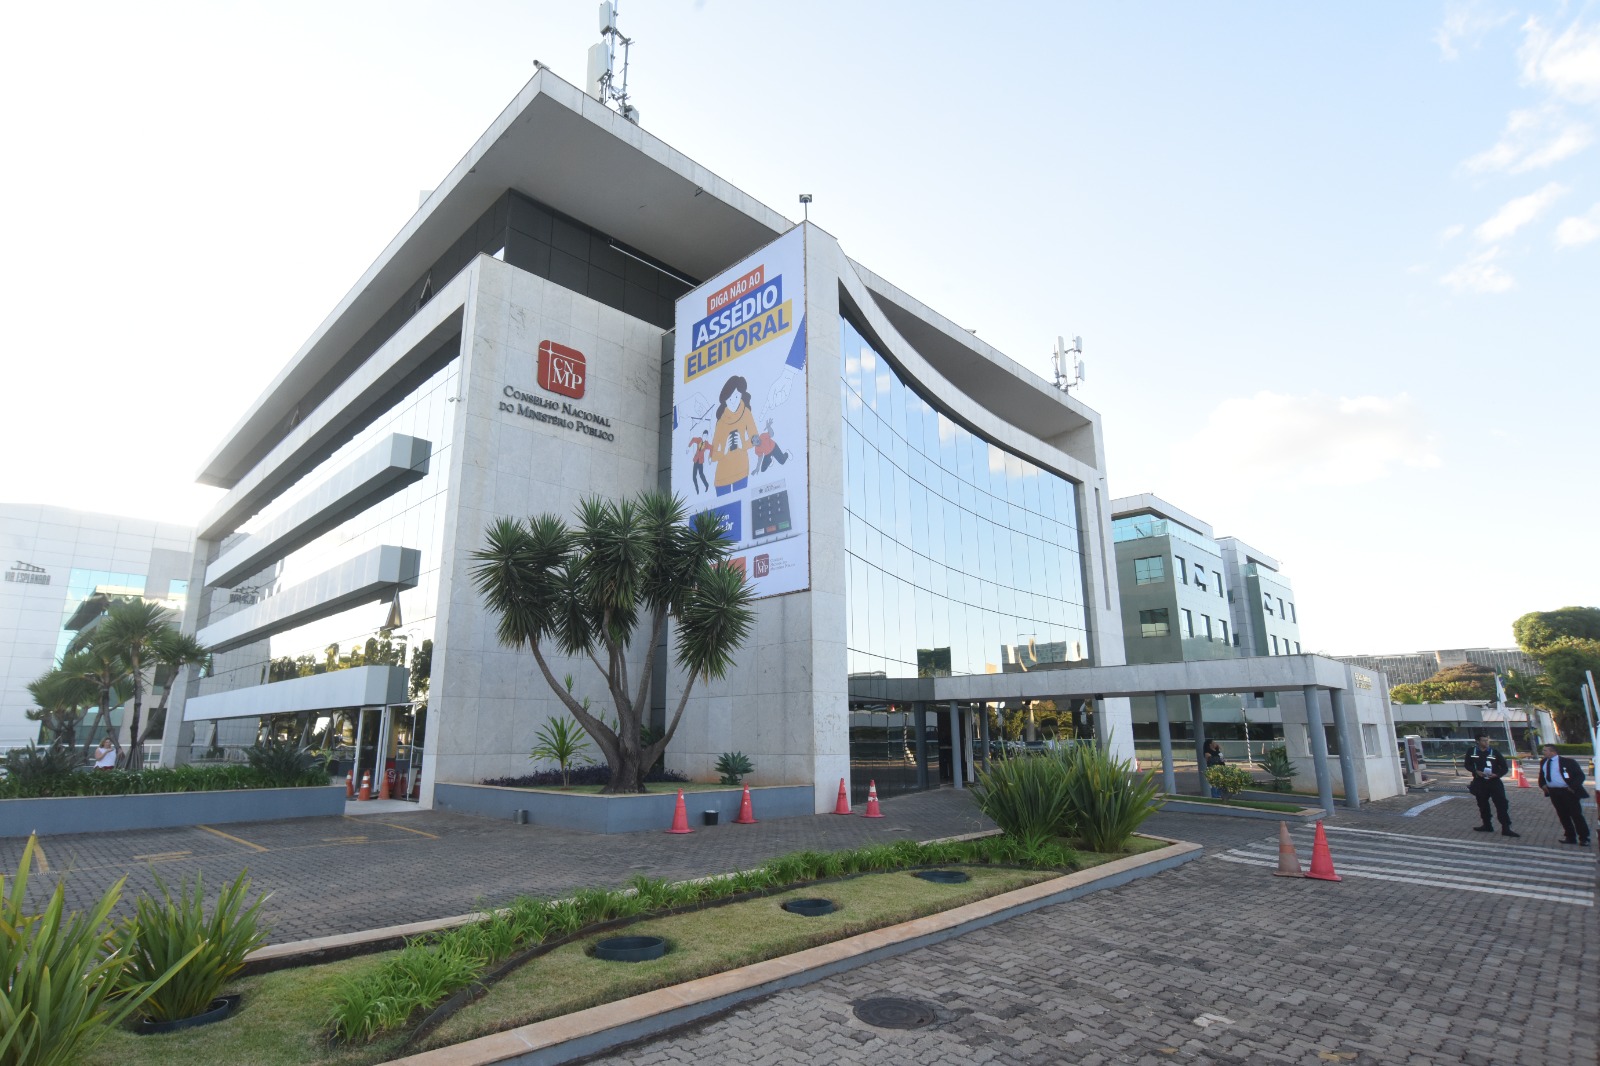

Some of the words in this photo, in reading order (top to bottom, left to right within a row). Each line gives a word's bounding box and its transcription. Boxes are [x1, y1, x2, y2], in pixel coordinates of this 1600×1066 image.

[696, 285, 778, 348] ASSÉDIO
[710, 291, 728, 311] DIGA
[730, 279, 747, 299] NÃO
[749, 271, 760, 287] AO
[687, 308, 790, 378] ELEITORAL
